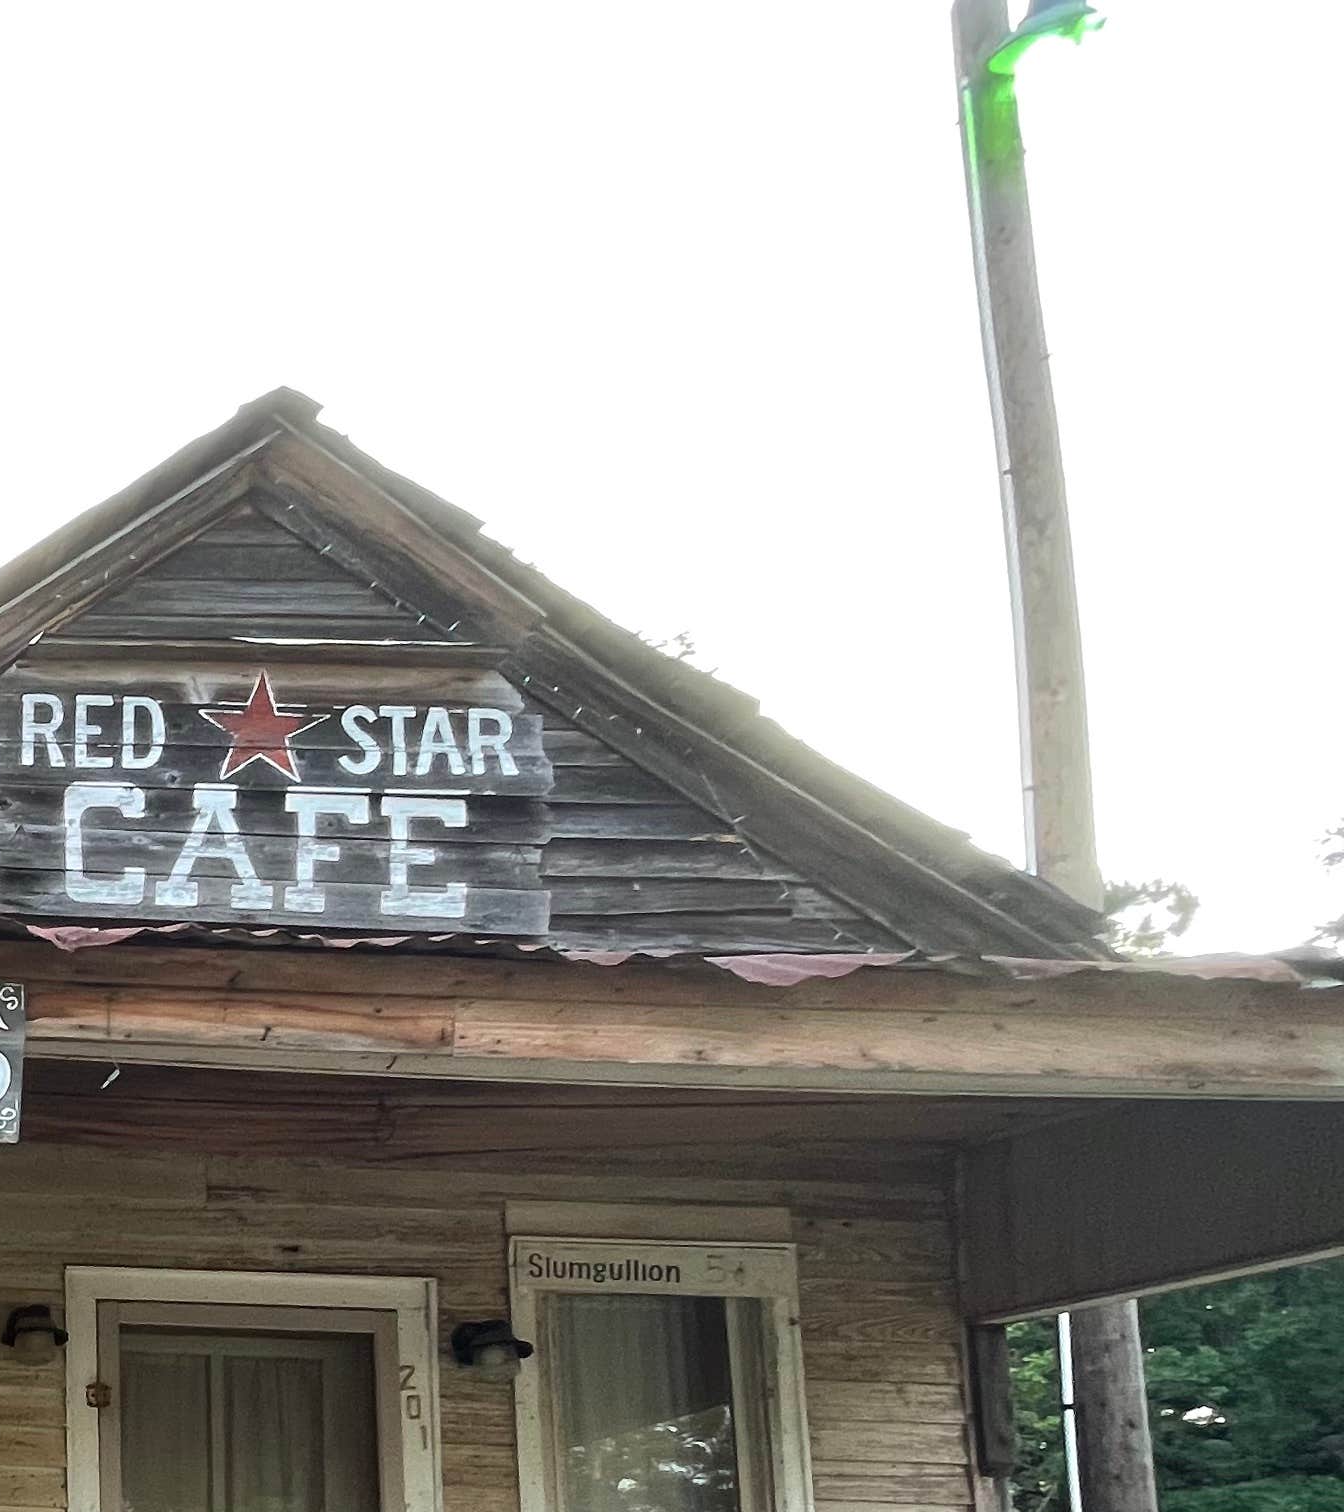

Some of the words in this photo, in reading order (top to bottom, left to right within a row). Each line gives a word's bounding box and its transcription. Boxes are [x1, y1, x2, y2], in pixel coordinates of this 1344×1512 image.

[21, 693, 166, 769] RED
[336, 703, 520, 777] STAR
[63, 781, 468, 918] CAFE
[528, 1252, 681, 1284] Slumgullion
[399, 1364, 427, 1450] 201
